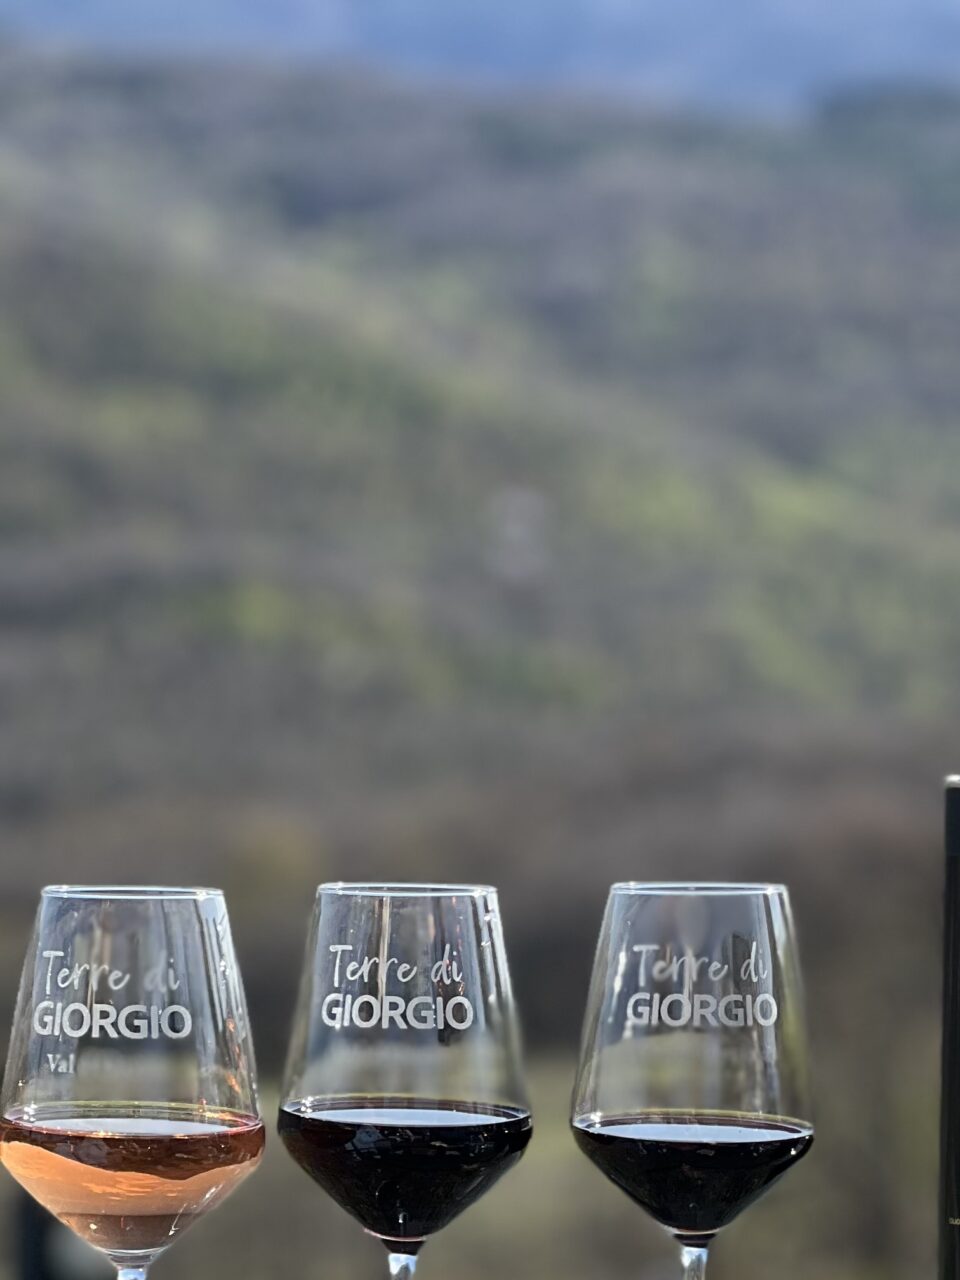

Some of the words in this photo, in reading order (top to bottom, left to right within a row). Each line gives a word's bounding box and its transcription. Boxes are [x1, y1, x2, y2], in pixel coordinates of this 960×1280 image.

[42, 950, 131, 996] Terre
[144, 953, 180, 993] di
[328, 944, 418, 988] Terre
[430, 943, 463, 985] di
[632, 944, 729, 988] Terre
[740, 941, 768, 983] di
[33, 1000, 193, 1040] GIORGIO
[321, 992, 474, 1031] GIORGIO
[626, 992, 778, 1028] GIORGIO
[46, 1053, 75, 1074] Val
